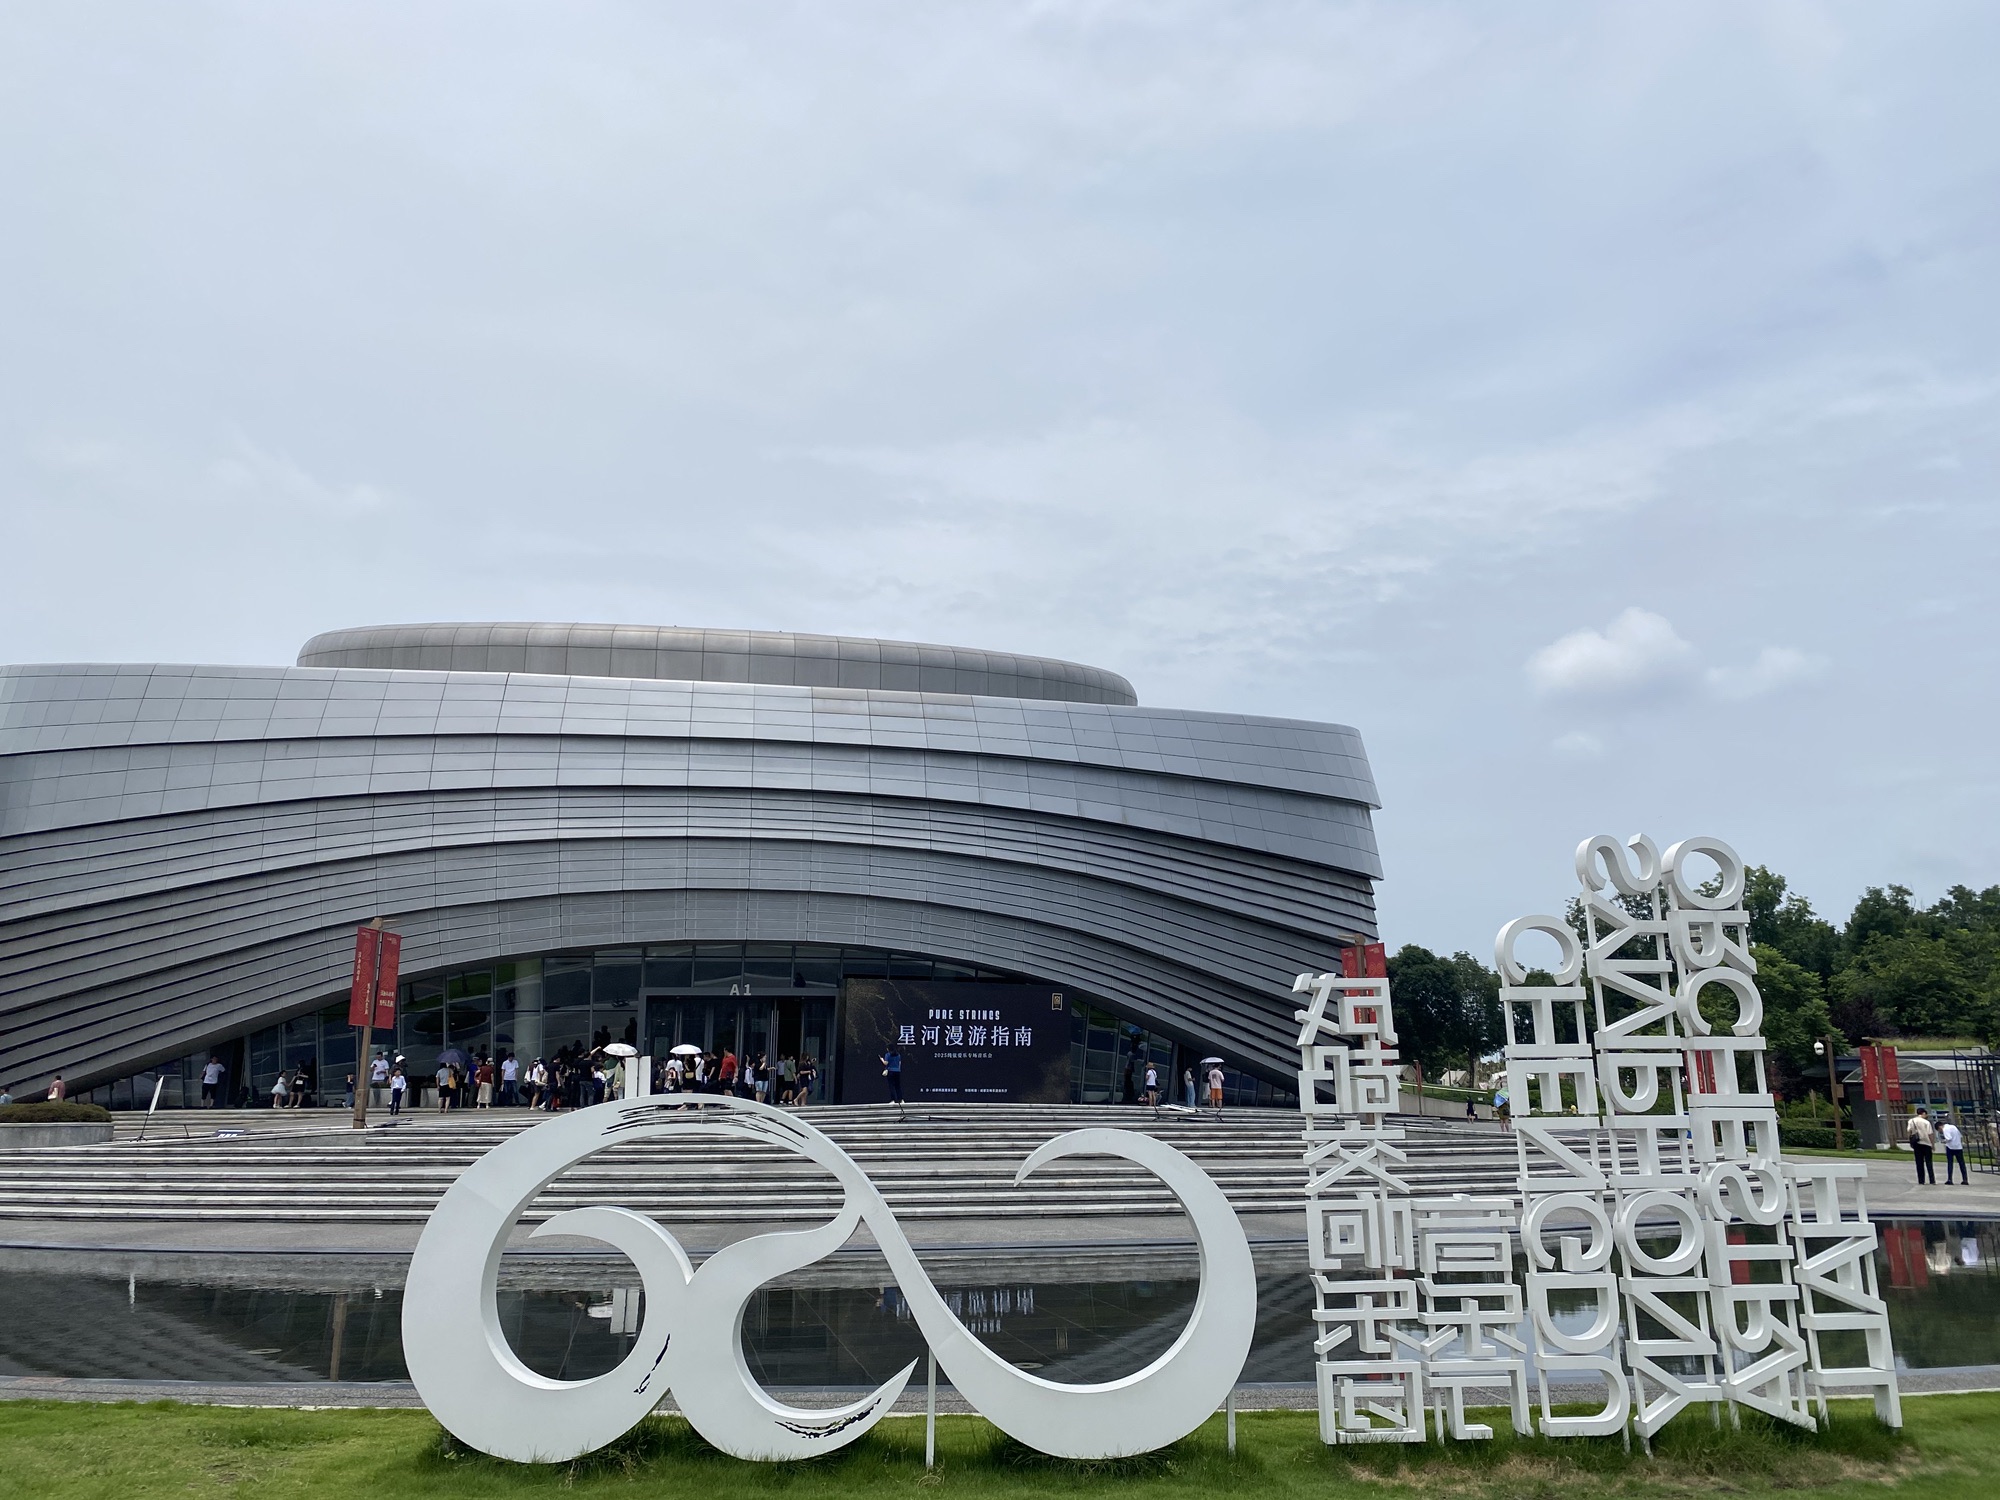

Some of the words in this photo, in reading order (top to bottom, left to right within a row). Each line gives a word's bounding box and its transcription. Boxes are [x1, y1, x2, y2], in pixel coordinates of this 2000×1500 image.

[729, 983, 752, 996] A1
[928, 1009, 954, 1020] PURE
[959, 1009, 1000, 1021] STRINGS
[896, 1024, 1033, 1047] 星河漫游指南
